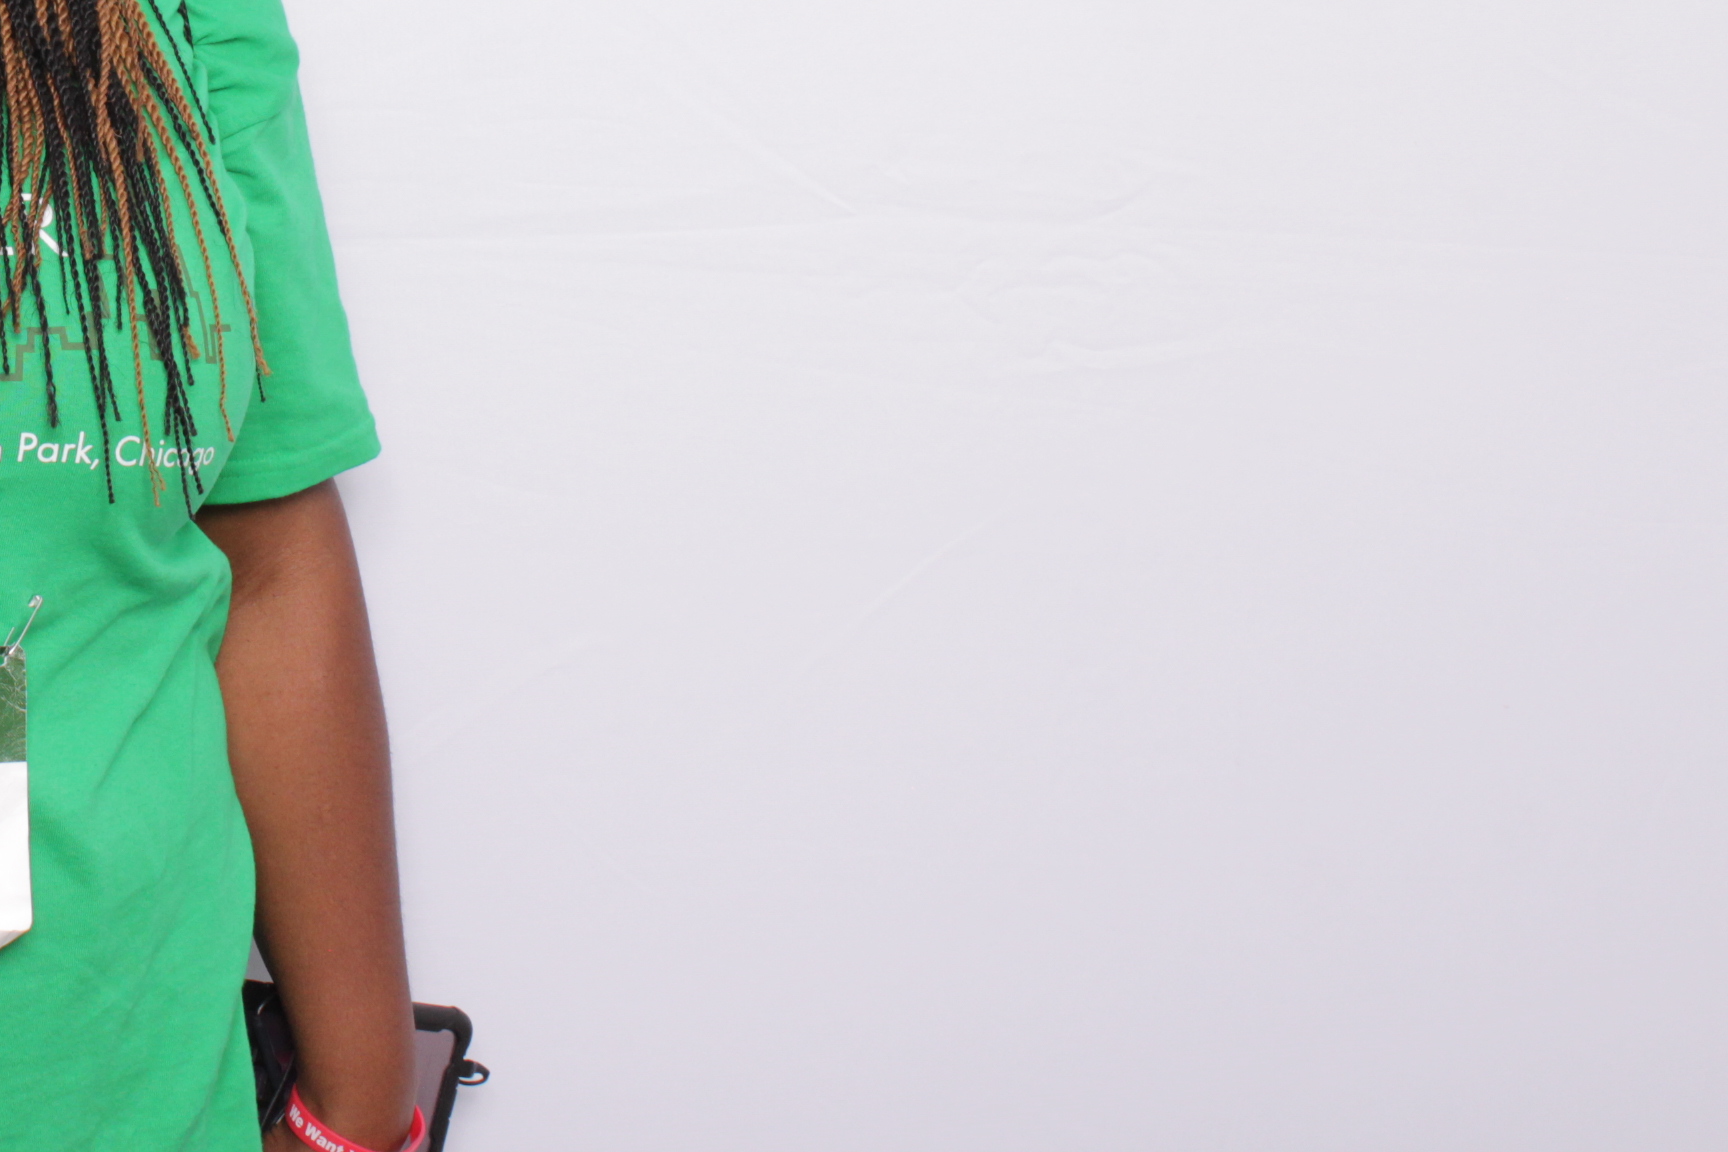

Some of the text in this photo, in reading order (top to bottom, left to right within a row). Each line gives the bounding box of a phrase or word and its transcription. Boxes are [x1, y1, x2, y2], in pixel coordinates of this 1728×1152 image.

[17, 431, 100, 470] Park,
[115, 435, 215, 476] Chicago
[289, 1104, 304, 1128] We
